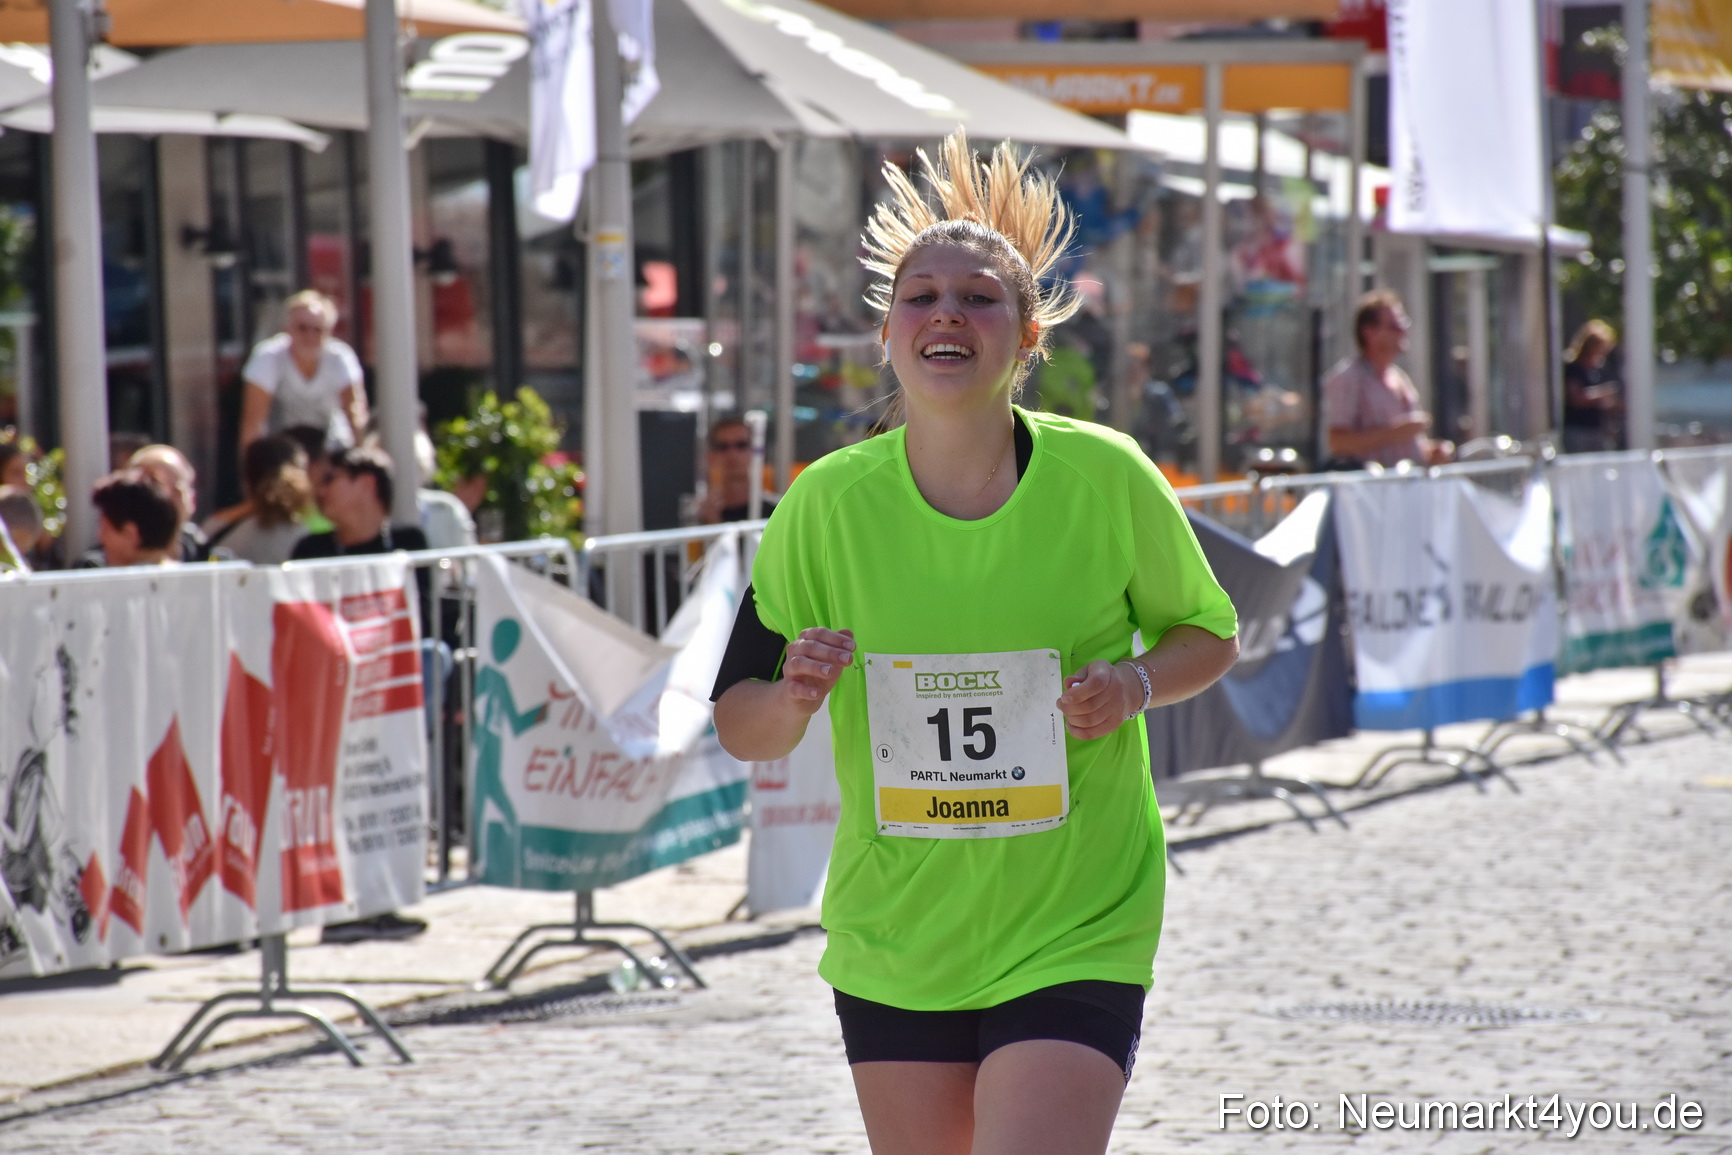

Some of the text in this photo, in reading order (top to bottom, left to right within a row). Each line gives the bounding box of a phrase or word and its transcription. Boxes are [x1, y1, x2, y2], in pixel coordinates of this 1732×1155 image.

[915, 671, 1002, 692] BOCK
[915, 692, 942, 700] inspired
[952, 691, 972, 699] smart
[973, 690, 1004, 698] concepts
[927, 706, 997, 762] 15
[881, 748, 889, 759] D
[910, 770, 947, 782] PARTL
[950, 769, 1008, 782] Neumarkt
[926, 796, 1010, 819] Joanna
